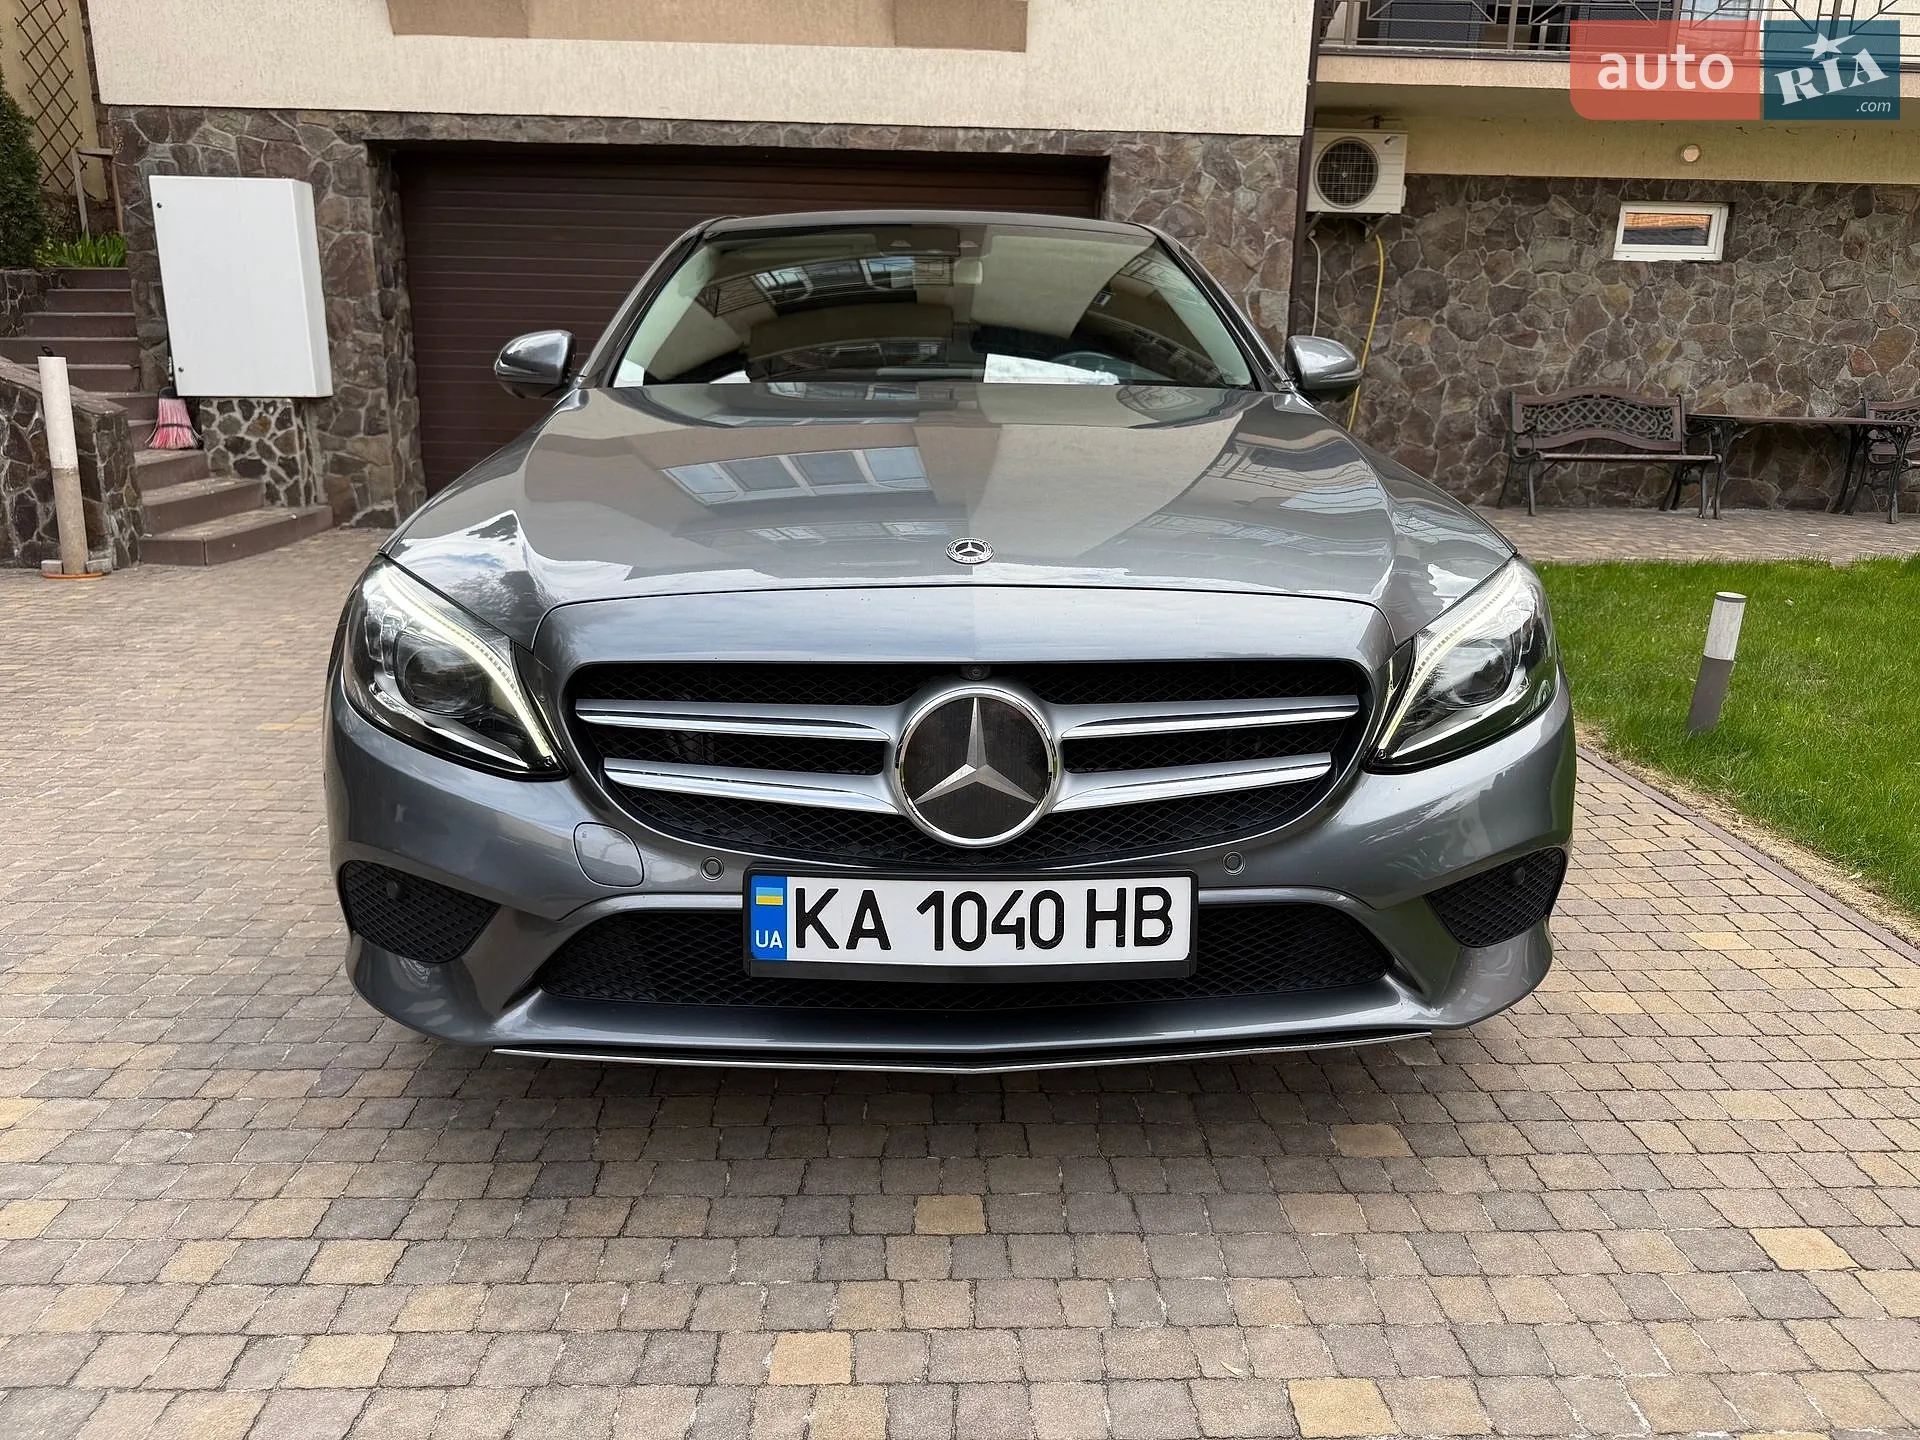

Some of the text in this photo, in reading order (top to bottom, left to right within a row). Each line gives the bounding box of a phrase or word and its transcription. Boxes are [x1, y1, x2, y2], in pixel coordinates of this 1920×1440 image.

[755, 930, 783, 949] UA
[795, 887, 1173, 952] KA 1040 HB
